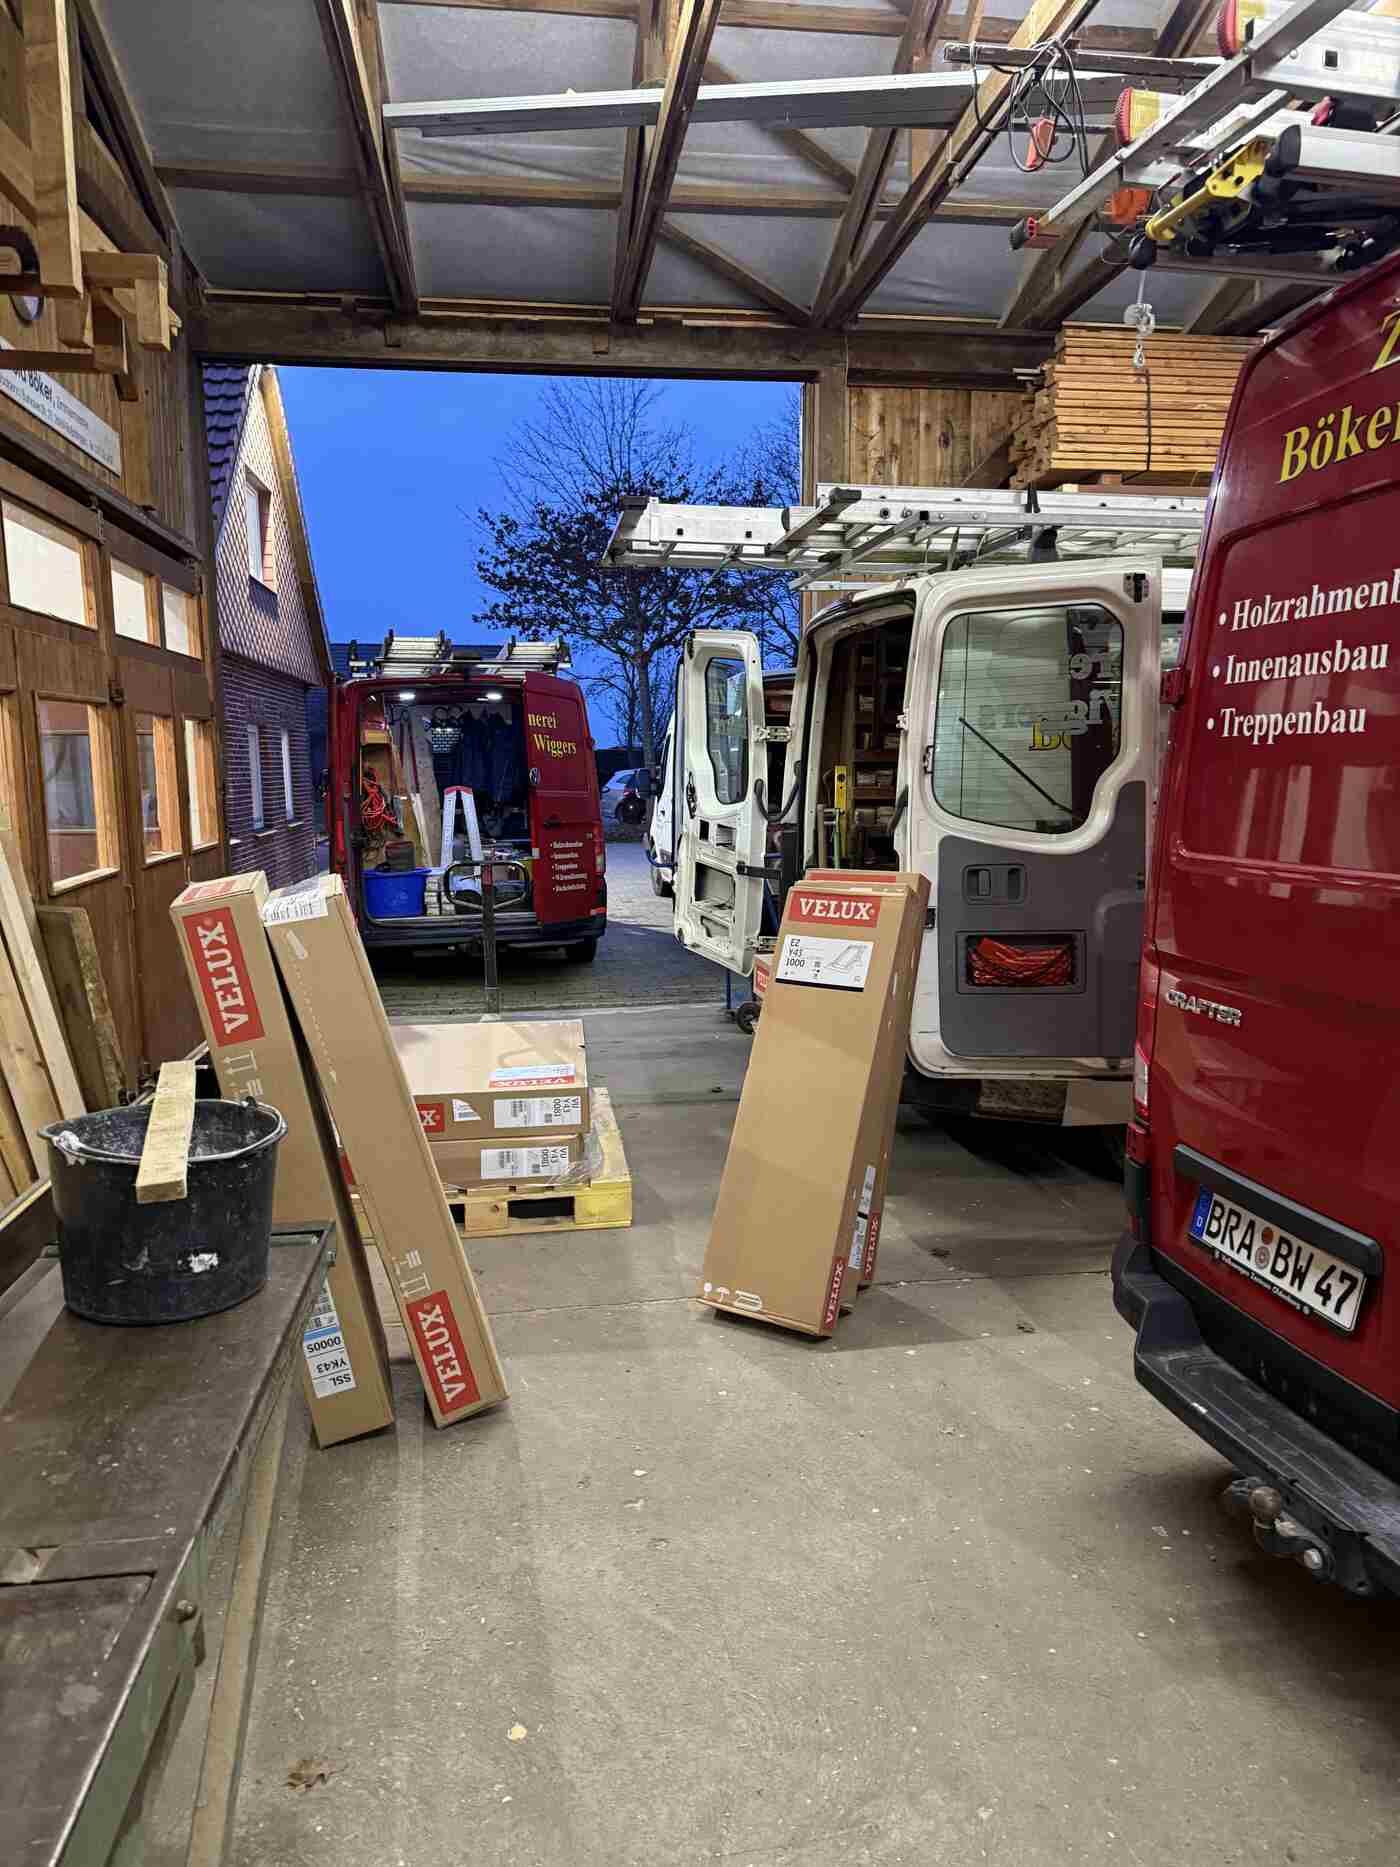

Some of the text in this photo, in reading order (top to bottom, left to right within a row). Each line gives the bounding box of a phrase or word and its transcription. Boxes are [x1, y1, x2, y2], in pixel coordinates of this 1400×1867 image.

[1224, 639, 1389, 685] Innenausbau
[1220, 701, 1367, 745] Treppenbau
[533, 733, 577, 758] Wiggers
[799, 897, 873, 921] VELUX
[197, 920, 249, 1035] VELUX
[1165, 989, 1242, 1028] CRAFTER
[1205, 1201, 1256, 1261] BRA
[1270, 1235, 1315, 1292] BW
[1314, 1264, 1359, 1315] 47
[316, 1358, 347, 1373] YK43
[417, 1304, 467, 1403] VELUX
[328, 1373, 352, 1387] SSL
